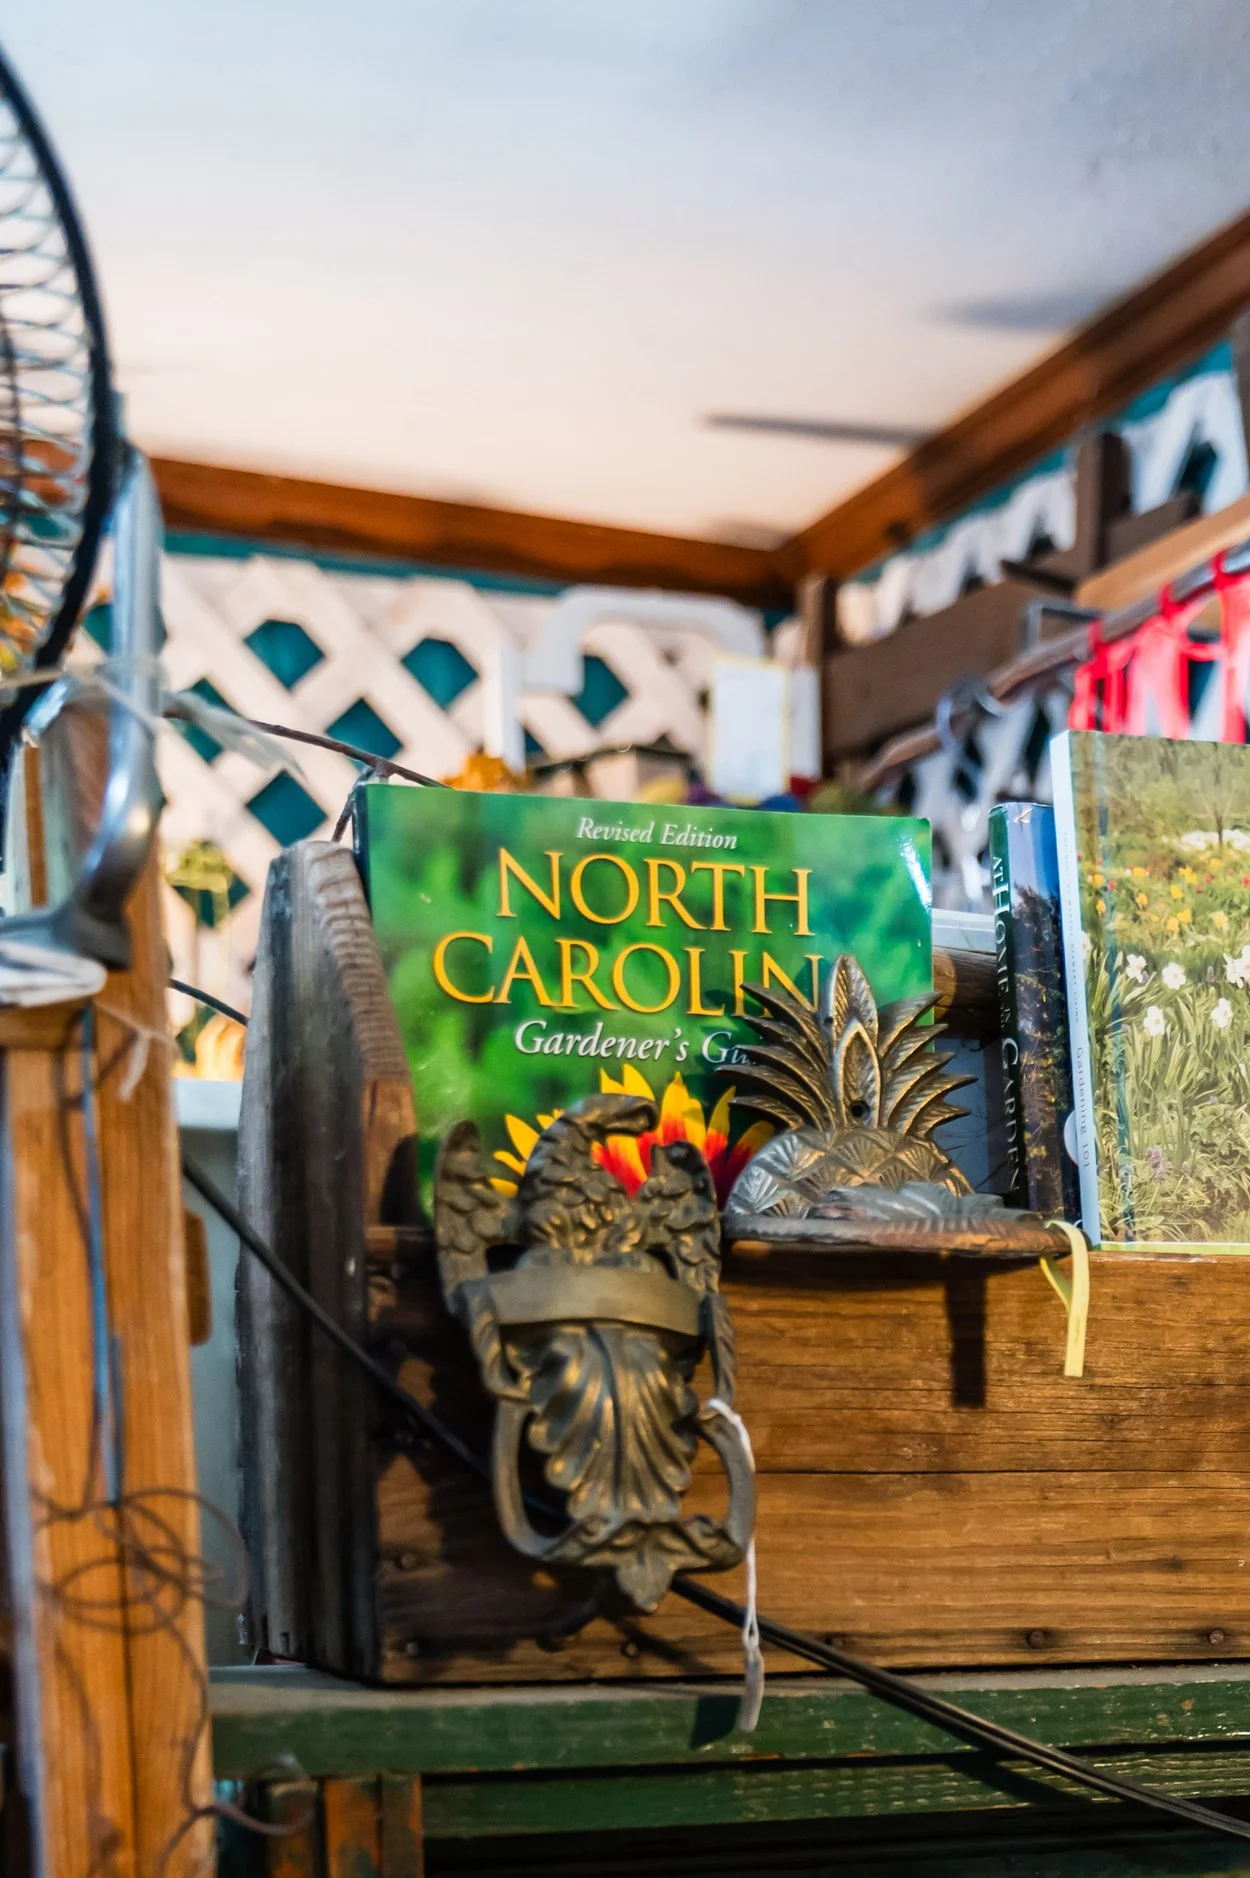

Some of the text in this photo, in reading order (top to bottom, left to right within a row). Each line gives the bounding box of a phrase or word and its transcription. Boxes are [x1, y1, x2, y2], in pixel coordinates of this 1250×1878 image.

[576, 817, 738, 849] Revised Edition
[993, 856, 1005, 882] AT
[496, 848, 815, 936] NORTH
[433, 931, 824, 1018] CAROLIN
[993, 883, 1011, 993] HOME
[514, 1020, 688, 1061] Gardener's
[1002, 1038, 1020, 1193] GARDEN
[1077, 1047, 1087, 1136] Gardening
